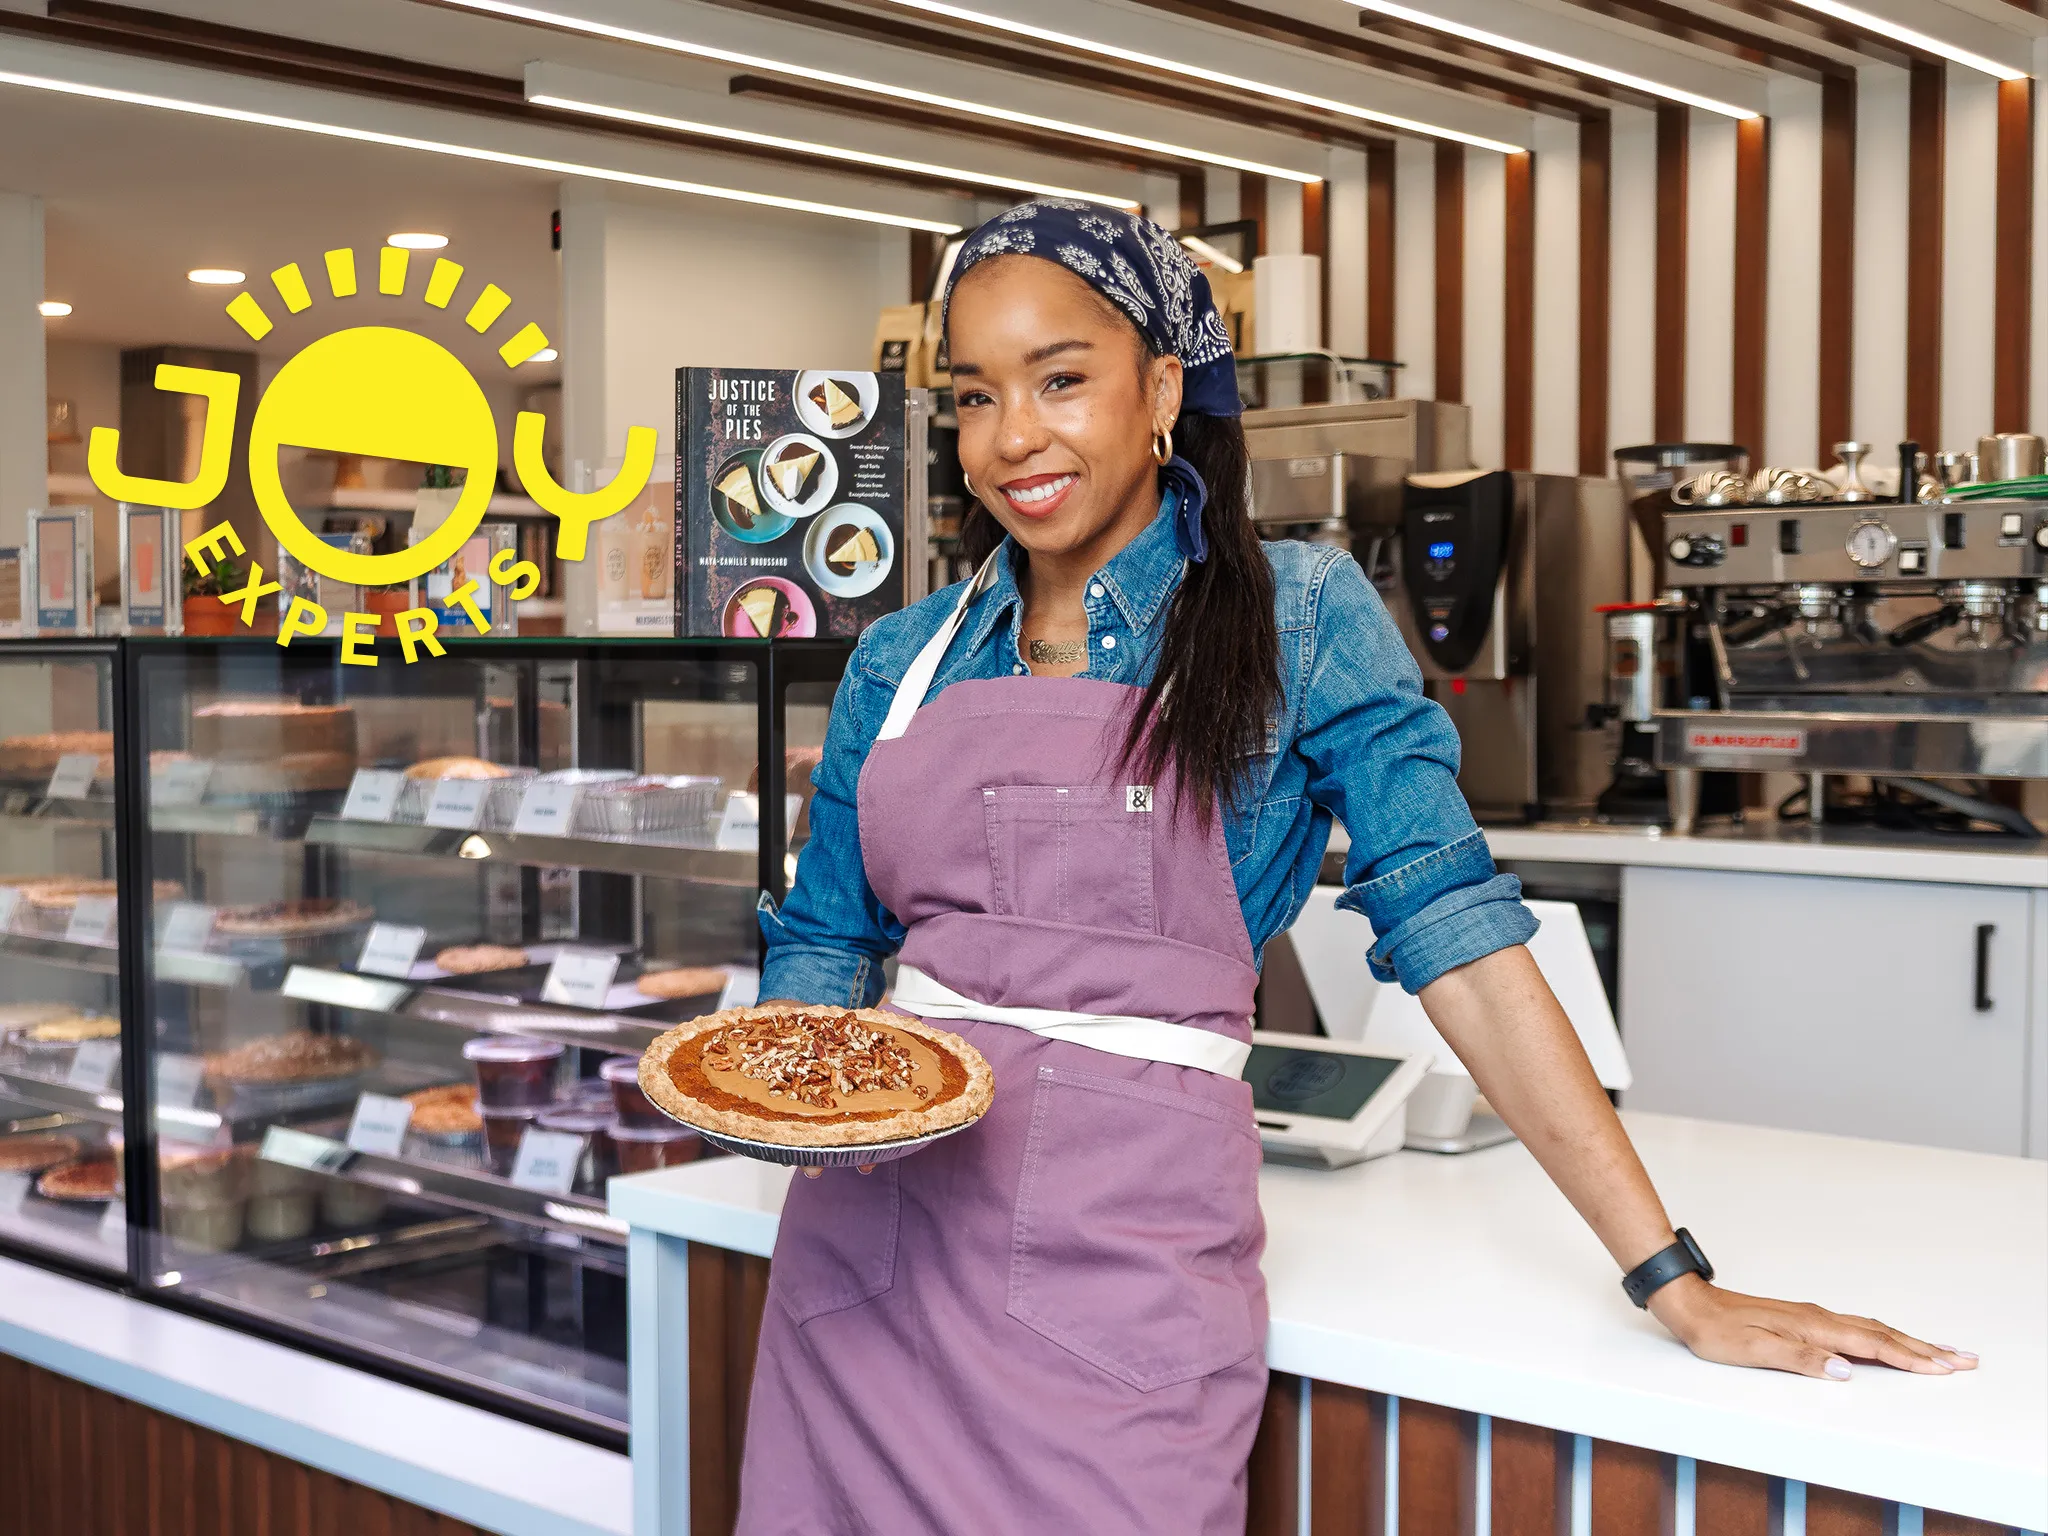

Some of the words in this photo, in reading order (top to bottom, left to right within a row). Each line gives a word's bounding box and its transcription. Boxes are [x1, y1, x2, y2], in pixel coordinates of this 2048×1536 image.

[708, 379, 776, 401] JUSTICE
[726, 404, 738, 416] OF
[743, 404, 761, 417] THE
[725, 418, 762, 440] PIES
[675, 454, 683, 495] JUSTICE
[675, 500, 683, 513] OF
[675, 519, 683, 537] THE
[675, 544, 683, 567] PIES
[699, 557, 748, 566] MAYA-CAMILLE
[750, 557, 788, 567] BROUSSARD
